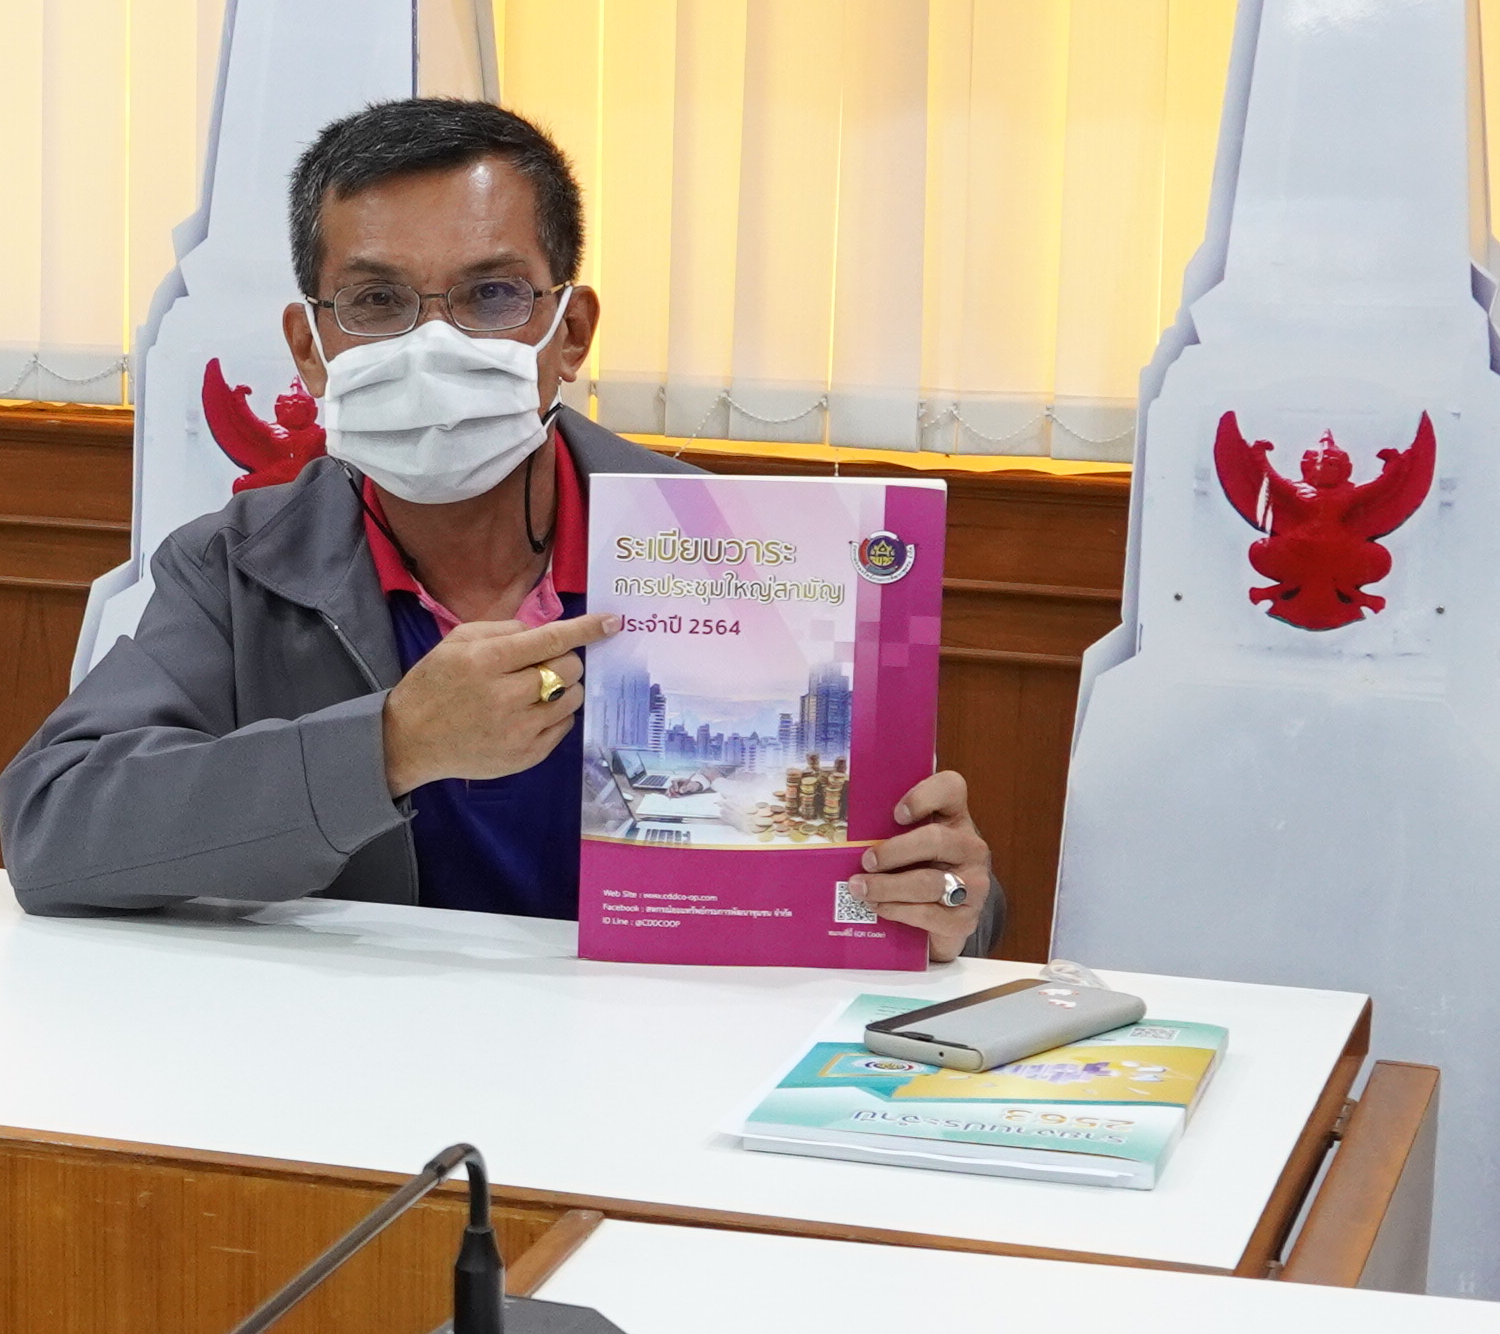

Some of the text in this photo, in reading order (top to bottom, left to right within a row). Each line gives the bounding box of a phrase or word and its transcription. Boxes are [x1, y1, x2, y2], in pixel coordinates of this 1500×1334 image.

[615, 528, 797, 566] ระเบียบวาระ
[614, 570, 845, 605] การประชุมใหญ่สามัญ
[688, 618, 742, 636] 2564
